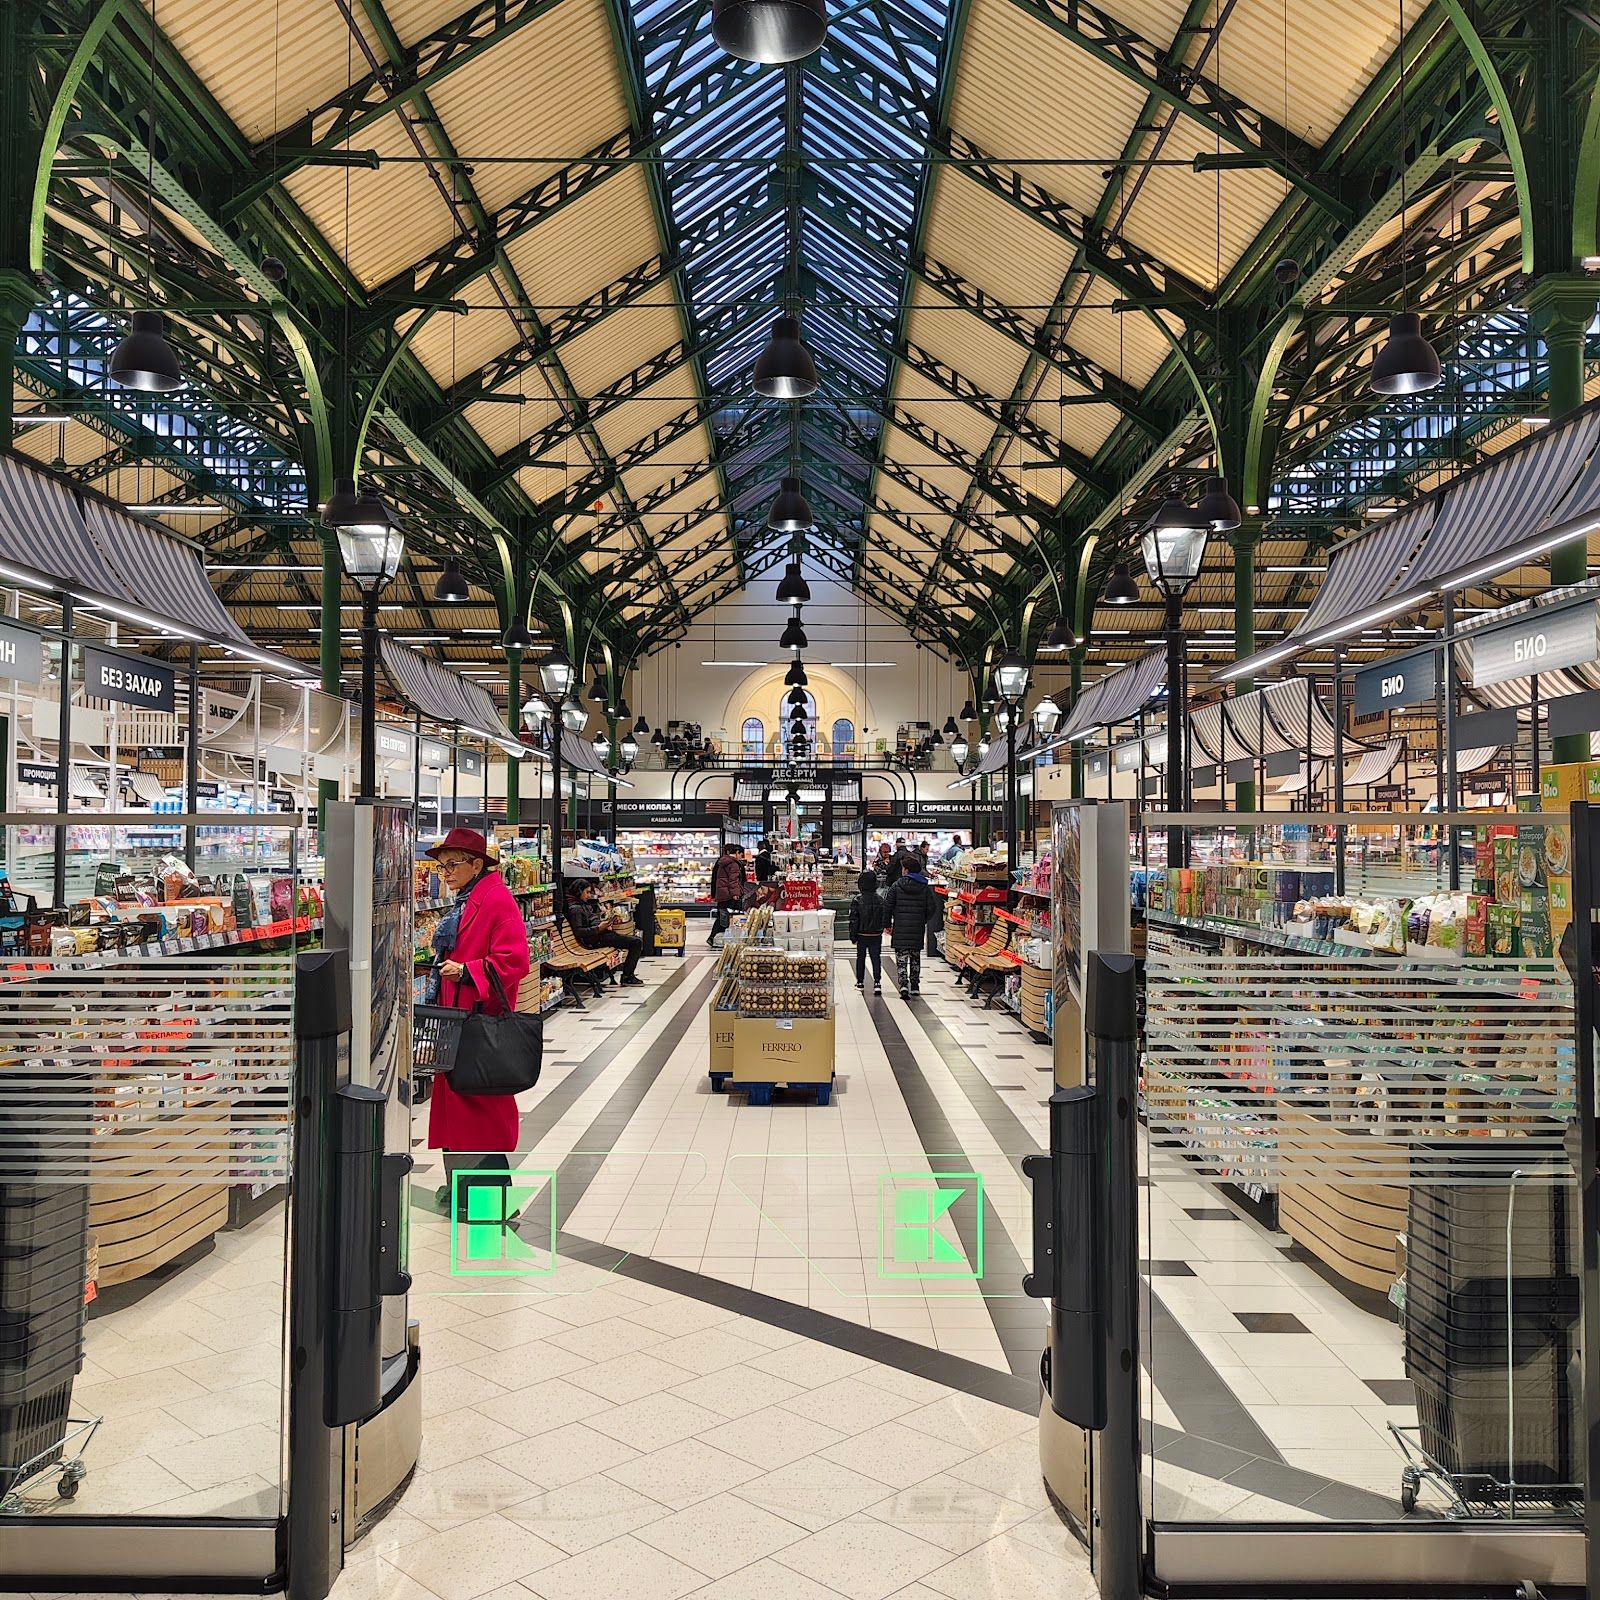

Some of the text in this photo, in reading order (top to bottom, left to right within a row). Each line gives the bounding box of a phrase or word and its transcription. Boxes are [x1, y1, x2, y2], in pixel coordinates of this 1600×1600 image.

[1514, 633, 1547, 662] БИО
[101, 666, 162, 698] БЕЗ ЗАХАР
[1381, 674, 1404, 698] БИО
[209, 704, 219, 717] ЗА
[23, 768, 57, 781] ПРОМОЦИЯ
[196, 786, 216, 797] РОМОЦИЯ
[1474, 780, 1502, 792] ПРОМОЦИЯ
[1543, 783, 1558, 797] Bio
[616, 803, 638, 811] МЕСО
[638, 803, 645, 811] И
[1551, 893, 1567, 908] Bio
[272, 923, 302, 934] РЕКЛАА
[762, 1042, 802, 1052] FERRERO
